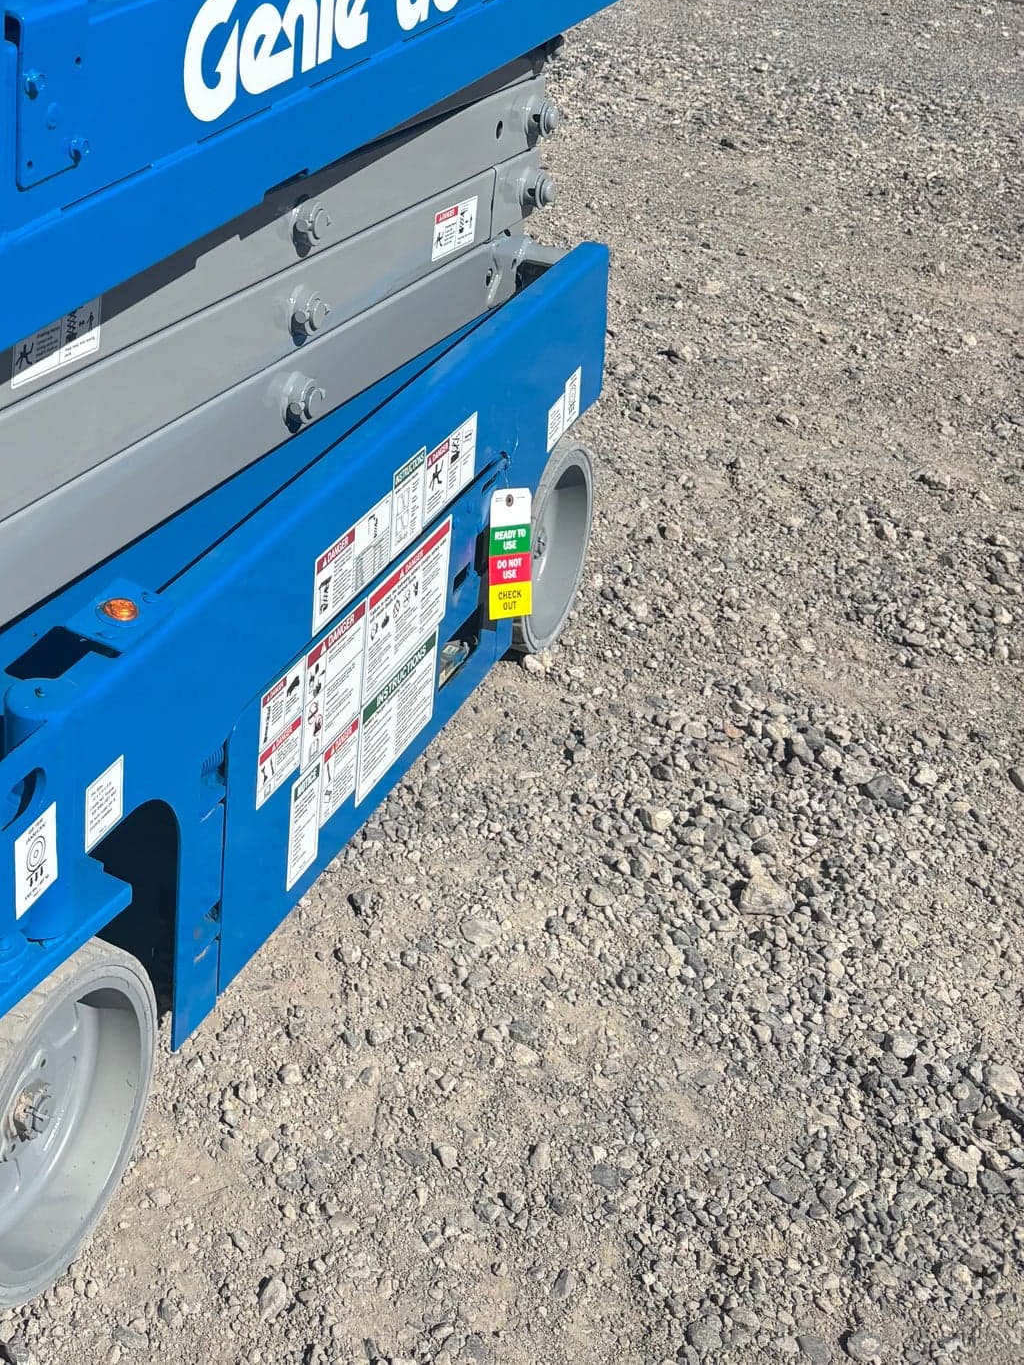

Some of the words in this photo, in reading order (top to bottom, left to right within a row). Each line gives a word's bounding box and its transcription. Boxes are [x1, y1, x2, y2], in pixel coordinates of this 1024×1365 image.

[494, 530, 517, 541] READY
[517, 528, 527, 538] TO
[327, 536, 349, 564] DANGER
[503, 540, 517, 550] USE
[497, 560, 507, 570] DO
[508, 558, 523, 568] NOT
[503, 571, 517, 579] USE
[498, 590, 522, 601] CHECK
[503, 601, 517, 611] OUT
[327, 614, 356, 647] DANGER
[376, 645, 427, 708] INSTRUCTIONS
[297, 768, 318, 797] NOTICE
